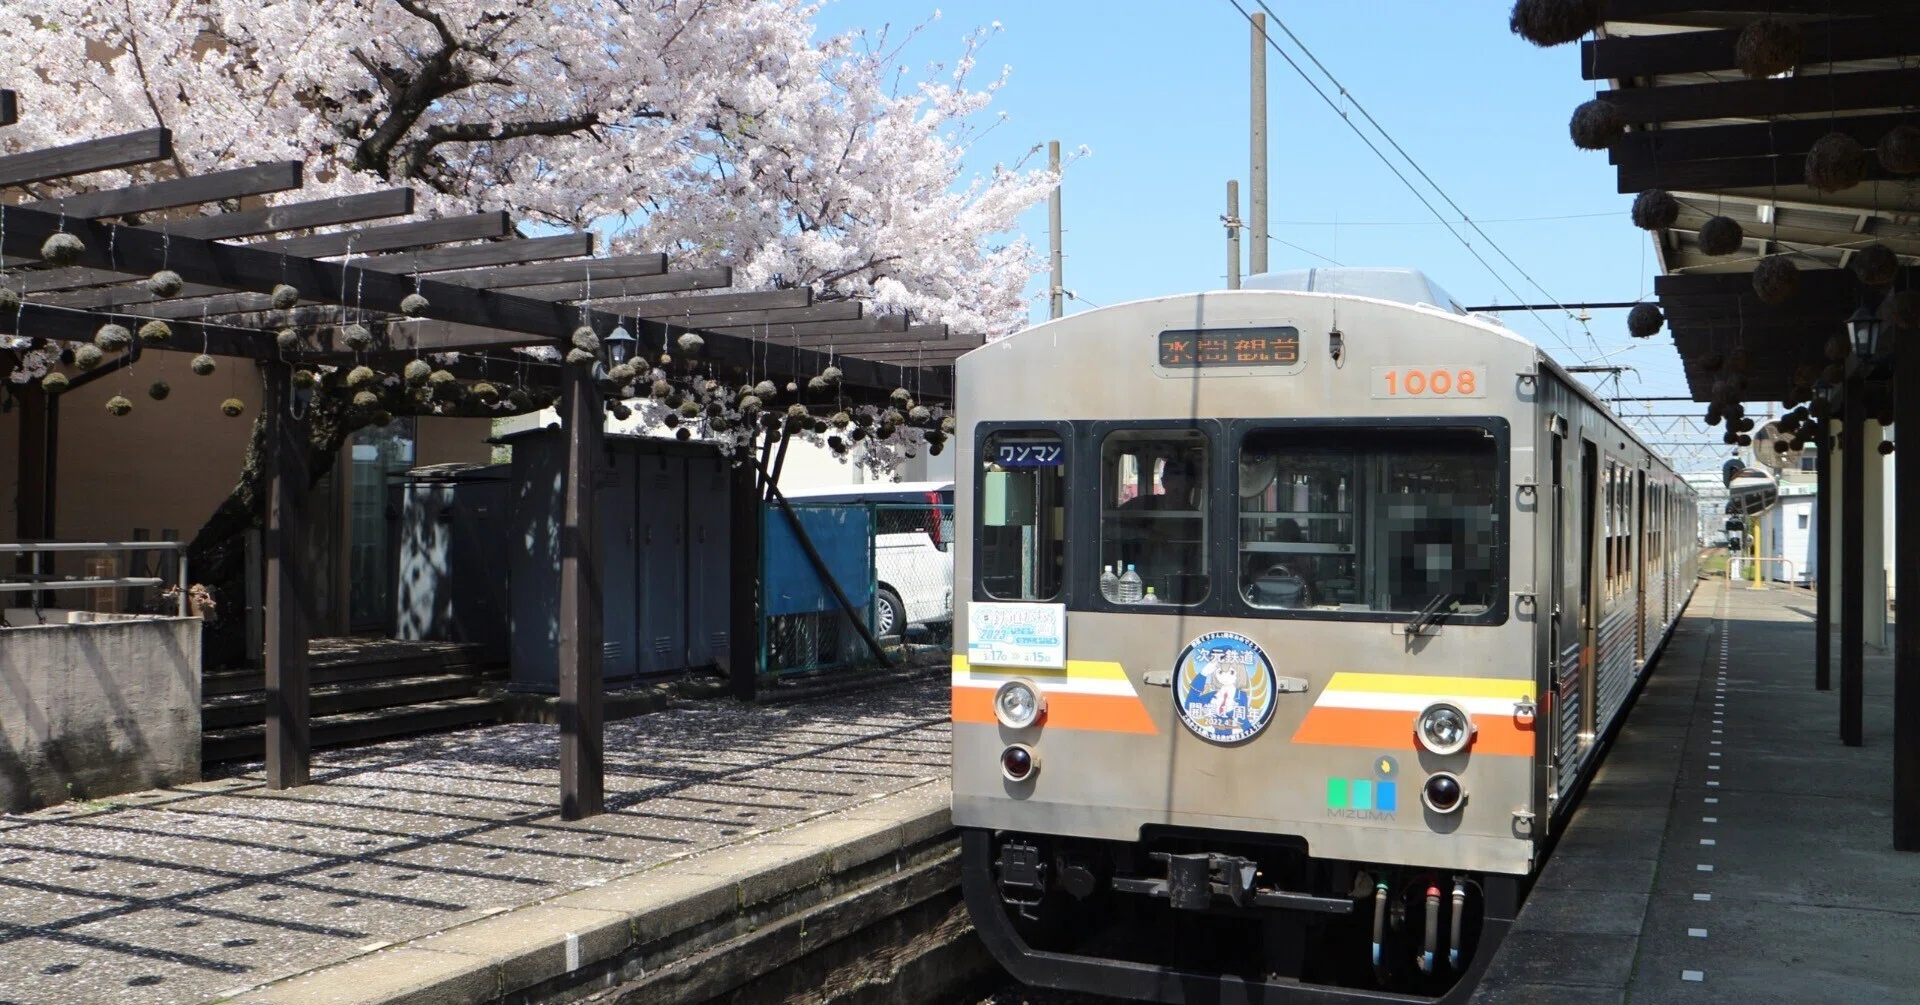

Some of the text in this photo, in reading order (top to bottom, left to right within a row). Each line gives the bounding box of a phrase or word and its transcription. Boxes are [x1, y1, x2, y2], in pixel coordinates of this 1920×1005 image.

[1384, 369, 1476, 395] 1008
[1000, 446, 1061, 462] ワンマン
[1196, 648, 1255, 665] 次元鉄道
[1327, 808, 1396, 821] MIZUMA
